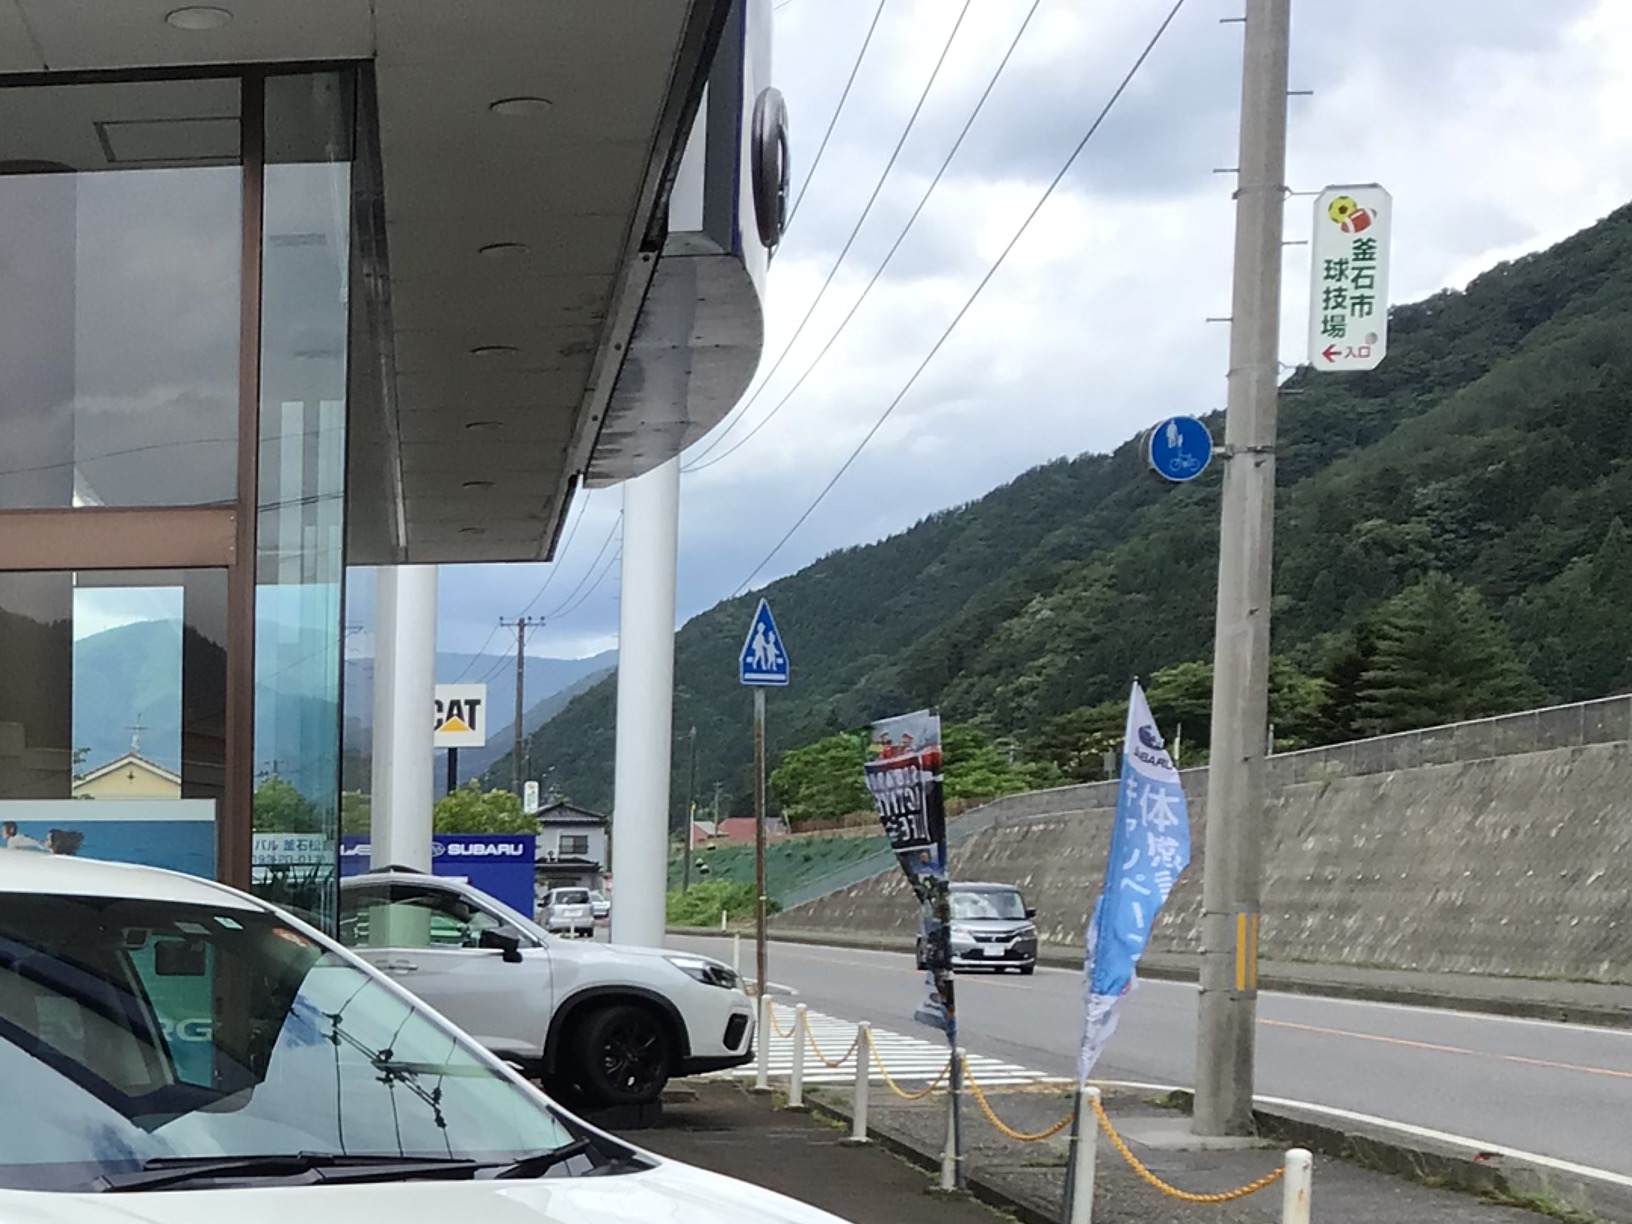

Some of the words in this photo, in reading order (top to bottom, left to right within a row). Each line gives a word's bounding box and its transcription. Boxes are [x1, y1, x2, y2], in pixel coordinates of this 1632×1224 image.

[1350, 237, 1377, 318] 釜石市
[1321, 257, 1350, 339] 球技場
[1344, 345, 1371, 359] 入口
[434, 699, 481, 731] CAT
[447, 843, 524, 855] SUBARU
